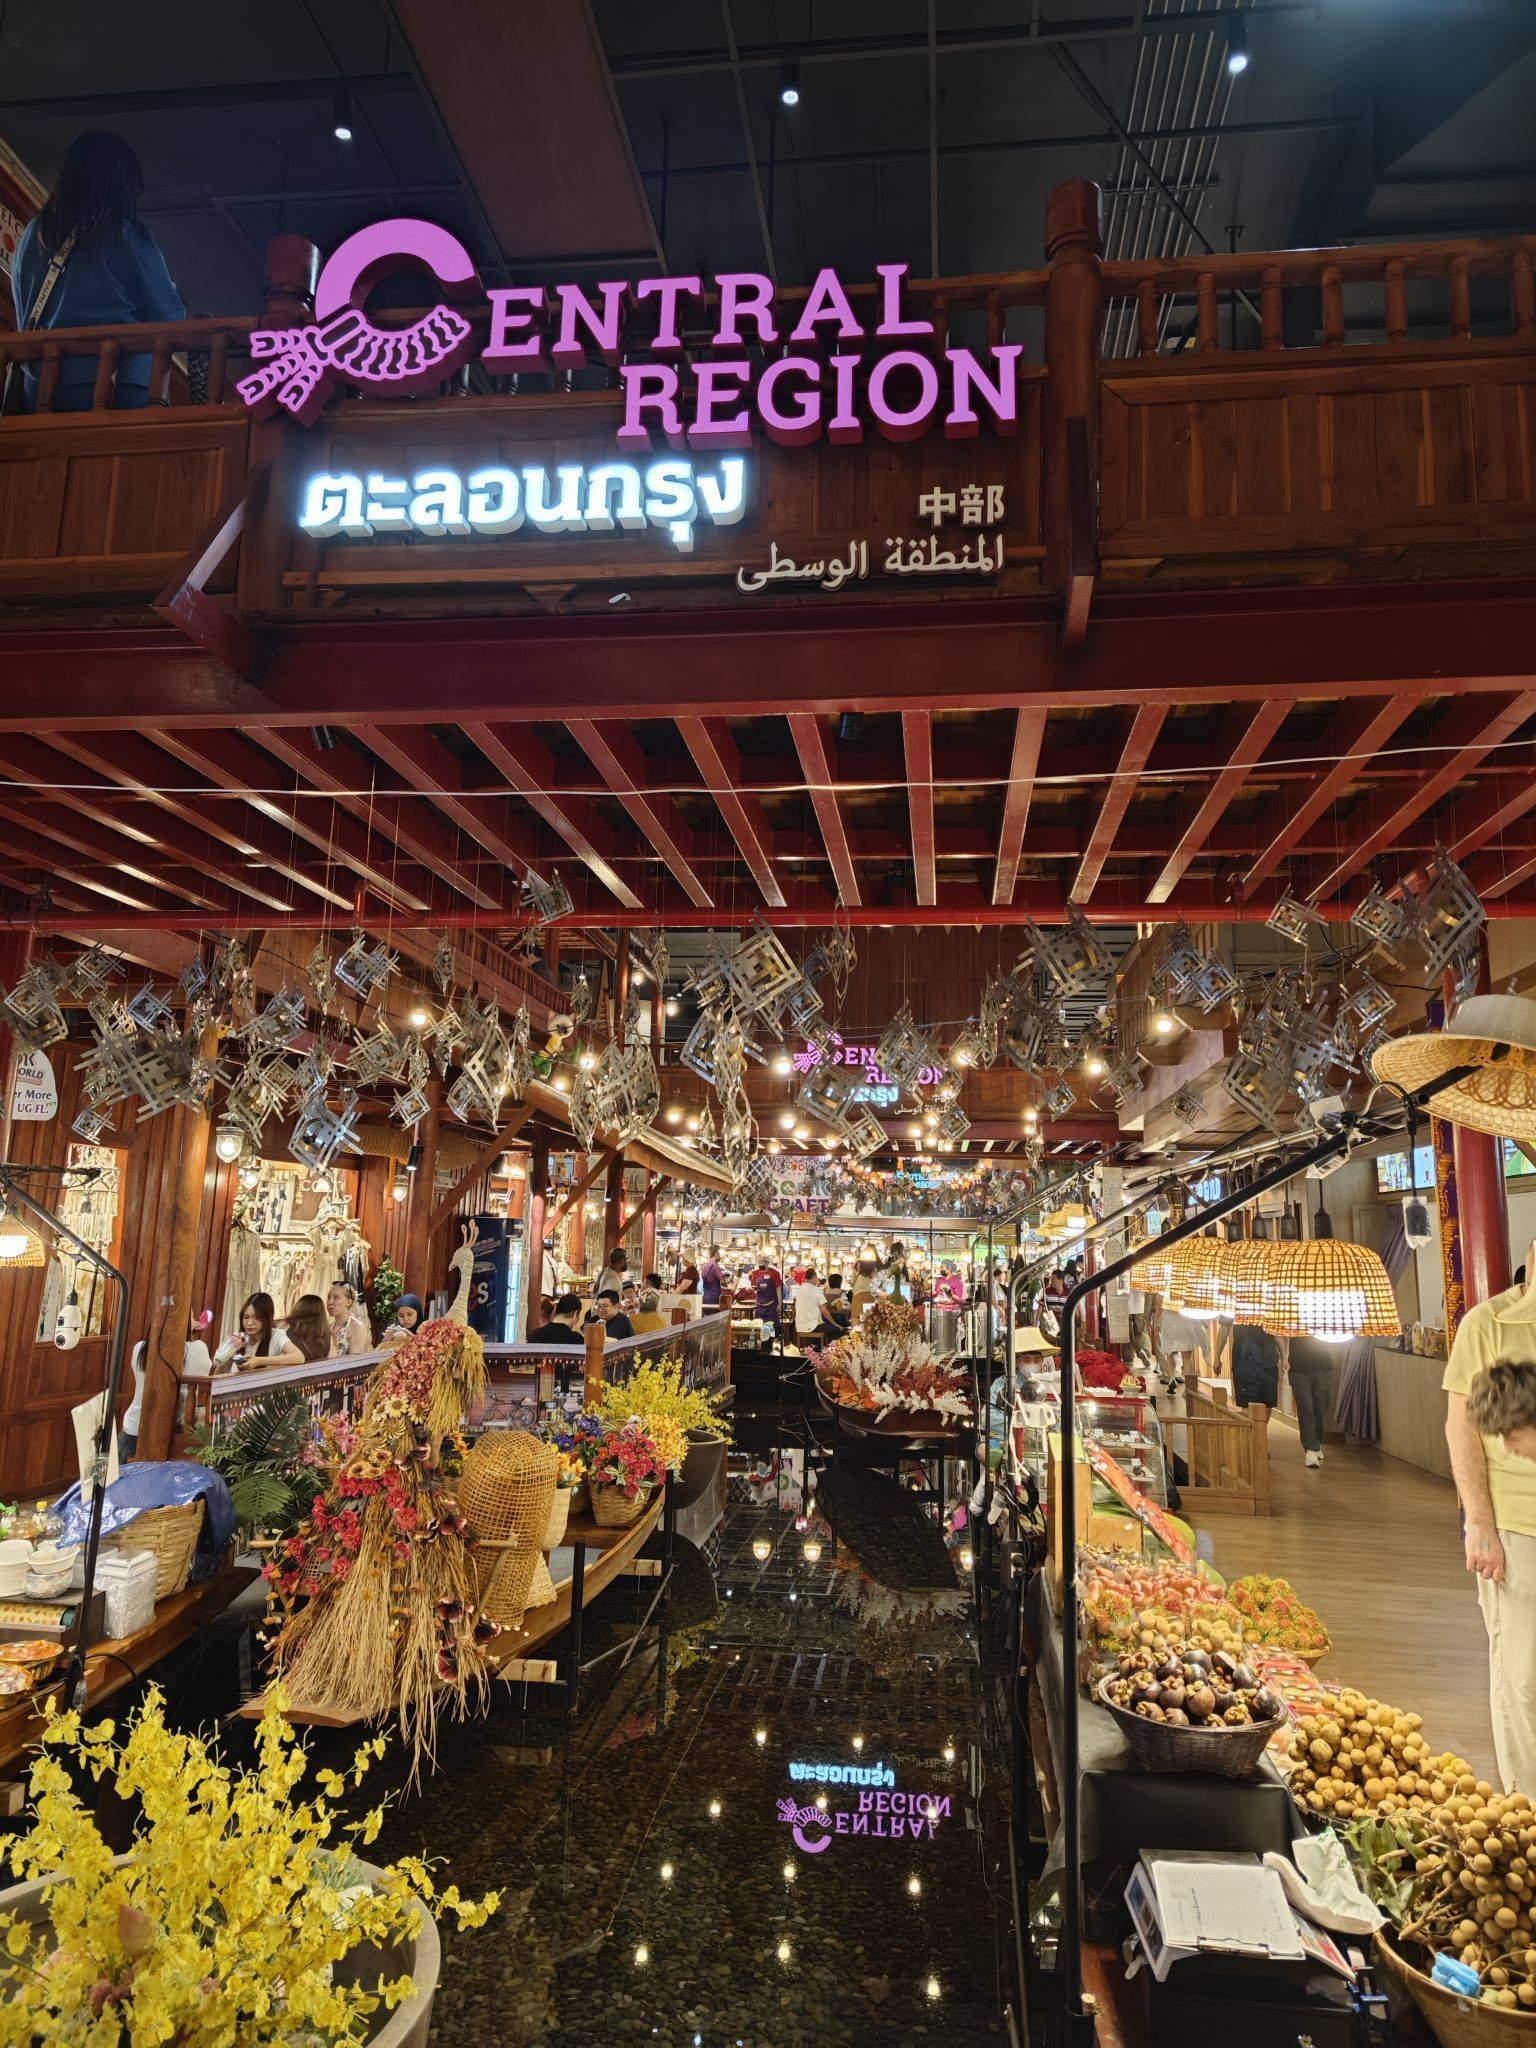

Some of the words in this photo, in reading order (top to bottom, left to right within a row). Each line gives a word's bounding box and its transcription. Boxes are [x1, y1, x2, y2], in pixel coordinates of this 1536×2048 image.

[237, 218, 934, 411] CENTRAL
[616, 344, 1024, 440] REGION
[299, 457, 746, 547] ตะลอนกรุง
[918, 483, 1006, 528] 中部
[737, 539, 869, 592] الوسطى
[884, 533, 1004, 574] المنطقة
[17, 1067, 44, 1079] ORLD
[24, 1089, 52, 1100] More
[17, 1103, 32, 1113] UG
